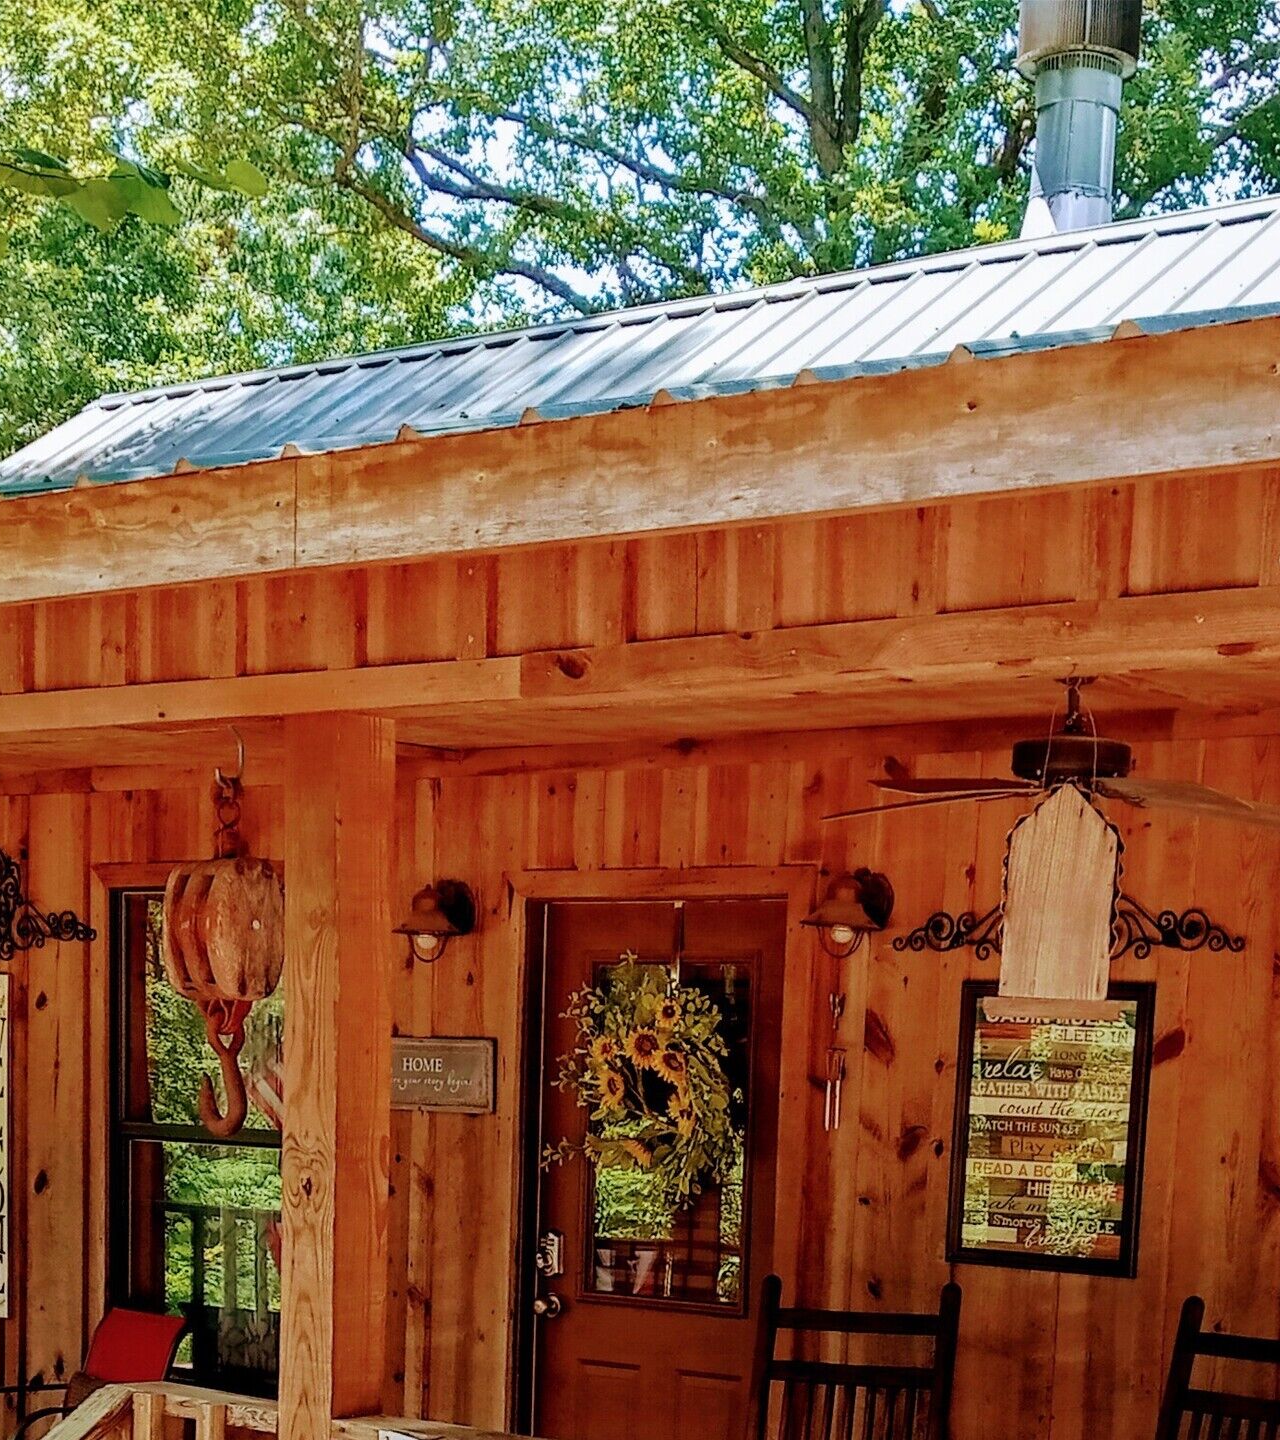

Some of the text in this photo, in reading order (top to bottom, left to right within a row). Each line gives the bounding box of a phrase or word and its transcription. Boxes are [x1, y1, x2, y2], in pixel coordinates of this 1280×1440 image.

[1054, 1028, 1105, 1043] SLEEP
[402, 1057, 443, 1072] HOME
[977, 1082, 1030, 1097] GATHER
[1035, 1084, 1070, 1098] WITH
[999, 1101, 1043, 1115] count
[1050, 1101, 1078, 1116] the
[975, 1118, 1013, 1131] WATCH
[1016, 1121, 1036, 1133] THE
[1010, 1140, 1045, 1157] play
[973, 1161, 1074, 1179] READ A BOOK
[1027, 1181, 1118, 1202] HIBERNATE
